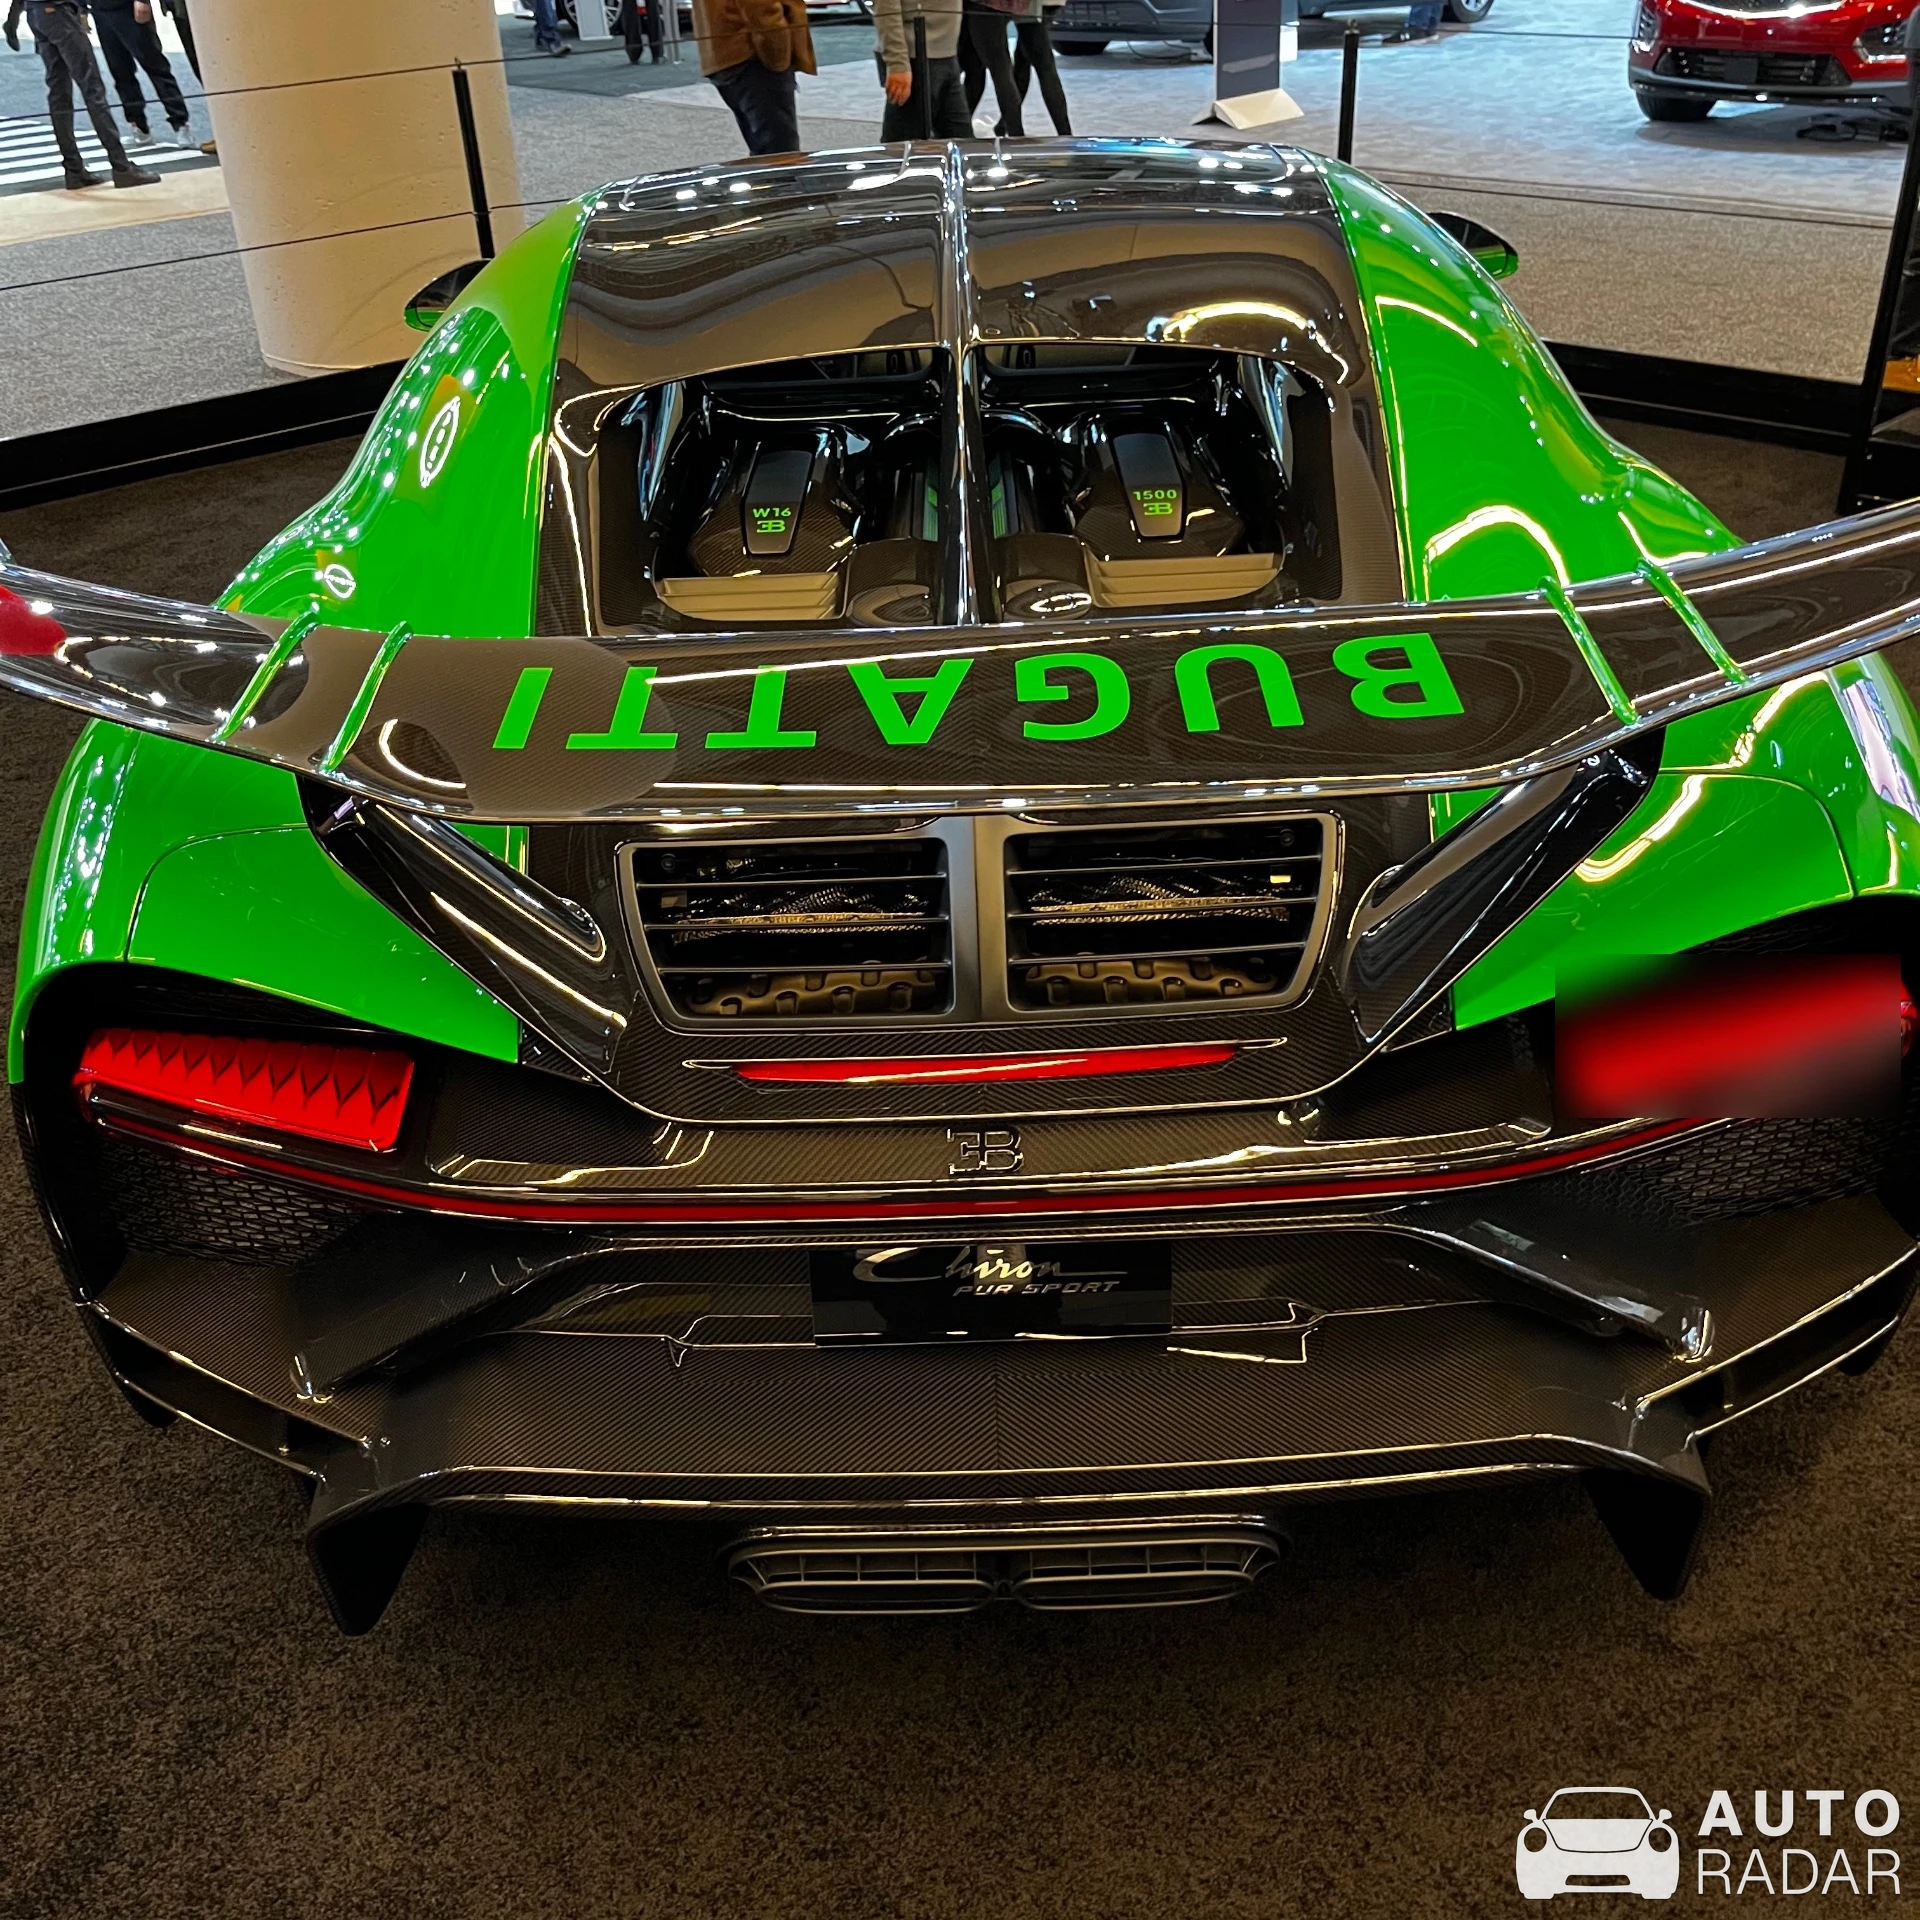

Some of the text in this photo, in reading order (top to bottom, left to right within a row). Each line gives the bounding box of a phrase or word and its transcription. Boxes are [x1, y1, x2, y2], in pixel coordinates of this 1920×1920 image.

[1132, 489, 1177, 501] 1500
[752, 507, 792, 518] W16
[492, 632, 1466, 750] BUGATTI
[852, 1245, 1128, 1283] Chiron
[952, 1280, 1121, 1297] PUR SPORT
